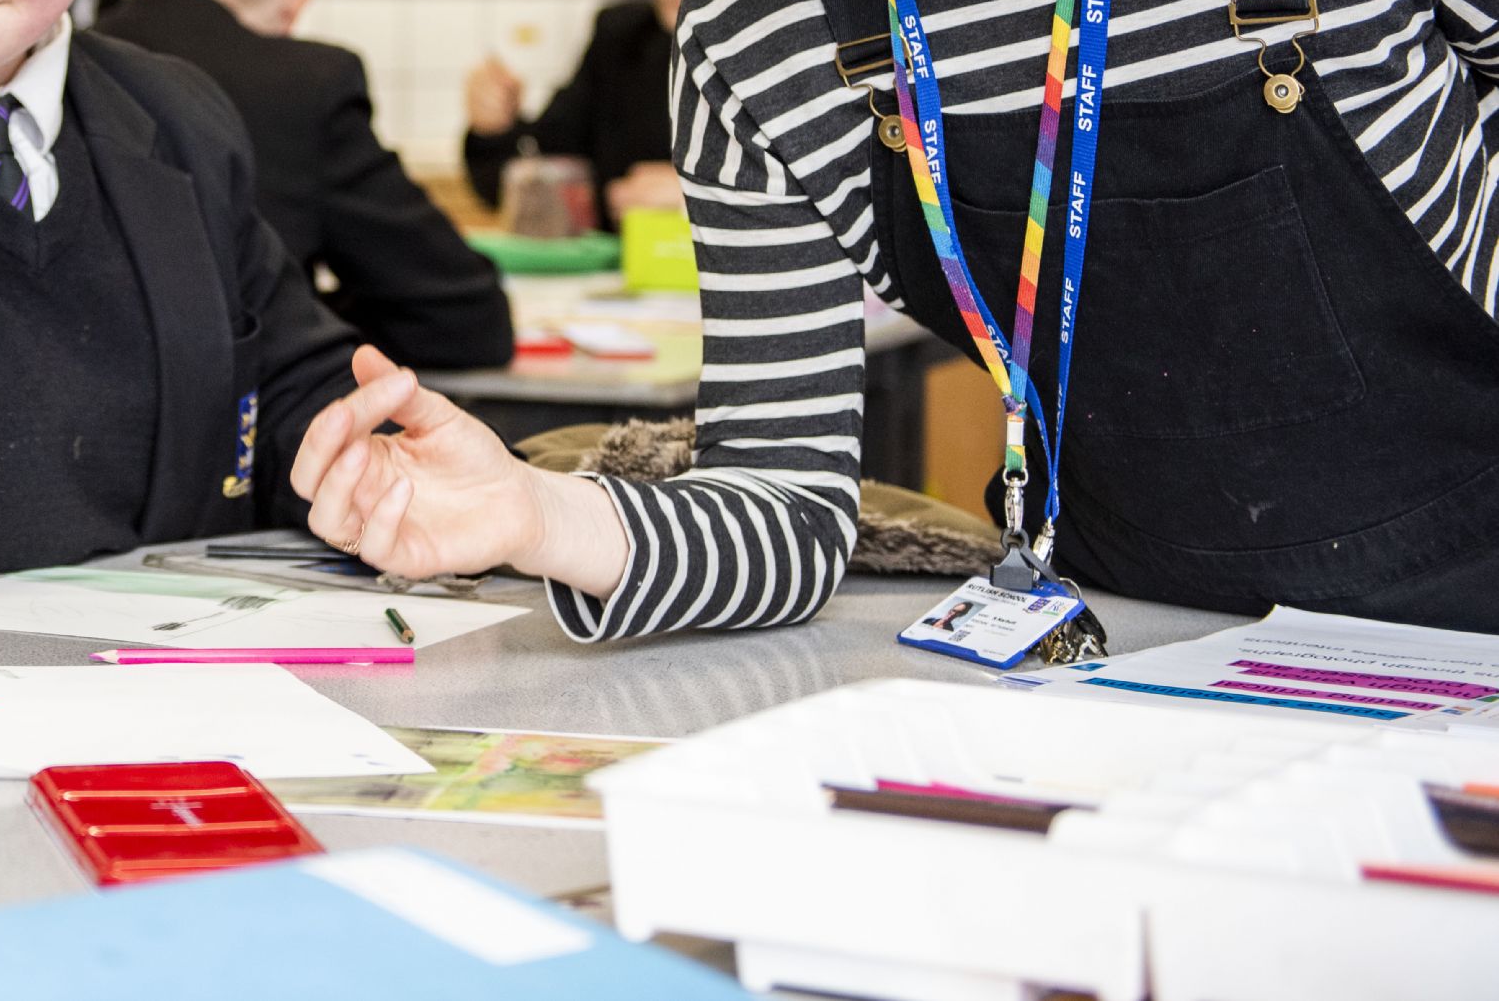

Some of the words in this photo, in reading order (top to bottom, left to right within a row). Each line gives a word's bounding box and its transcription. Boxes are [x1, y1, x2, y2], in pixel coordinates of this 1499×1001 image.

[903, 14, 930, 79] STAFF
[1077, 63, 1098, 133] STAFF
[923, 118, 942, 185] STAFF
[1069, 170, 1088, 240] STAFF
[1060, 276, 1076, 345] STAFF
[986, 324, 1012, 364] STA
[1238, 660, 1294, 670] and
[1242, 668, 1356, 685] various
[1301, 668, 1468, 687] processes
[1098, 678, 1257, 703] Experiment
[1217, 681, 1316, 696] critical
